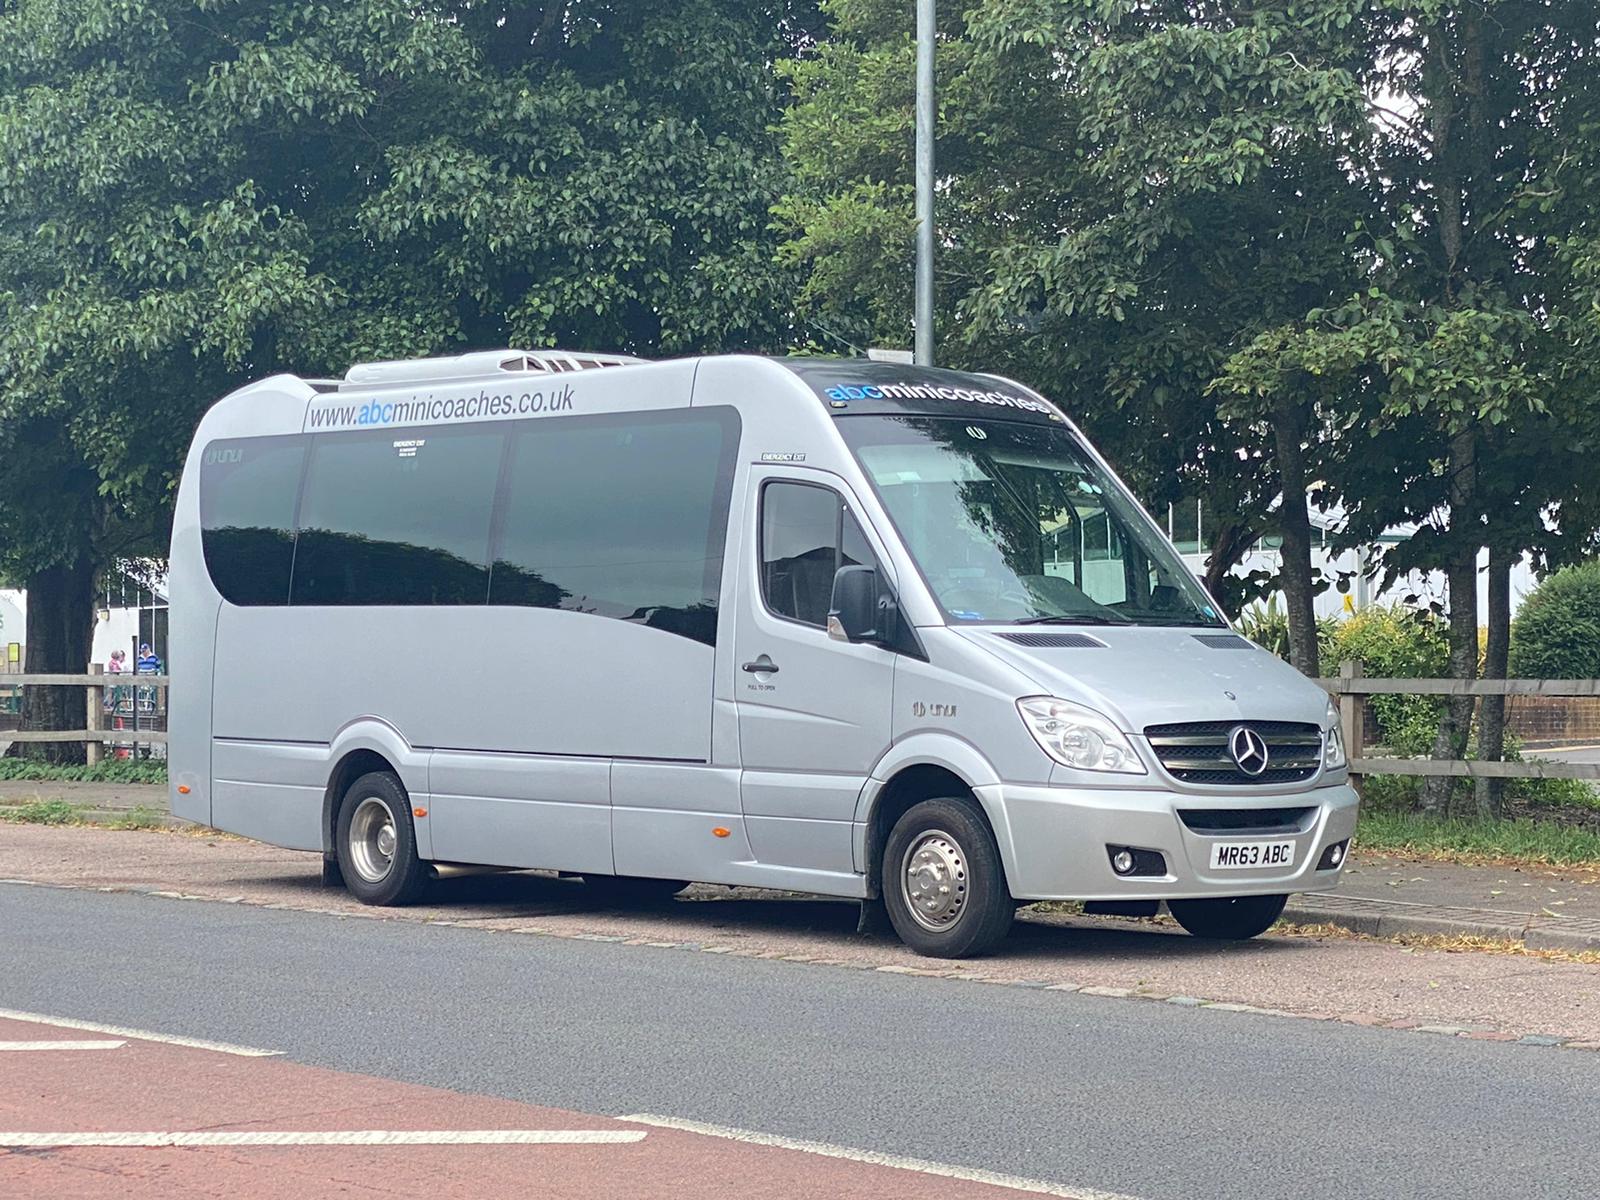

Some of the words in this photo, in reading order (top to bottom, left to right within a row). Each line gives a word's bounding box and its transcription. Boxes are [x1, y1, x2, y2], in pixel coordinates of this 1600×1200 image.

[309, 383, 575, 427] www.abcminicoaches.co.uk
[824, 383, 1051, 415] abcminicoaches
[762, 453, 793, 461] EMERGENCY
[793, 453, 805, 461] EXIT
[1218, 846, 1259, 865] MR63
[1262, 844, 1289, 864] ABC
